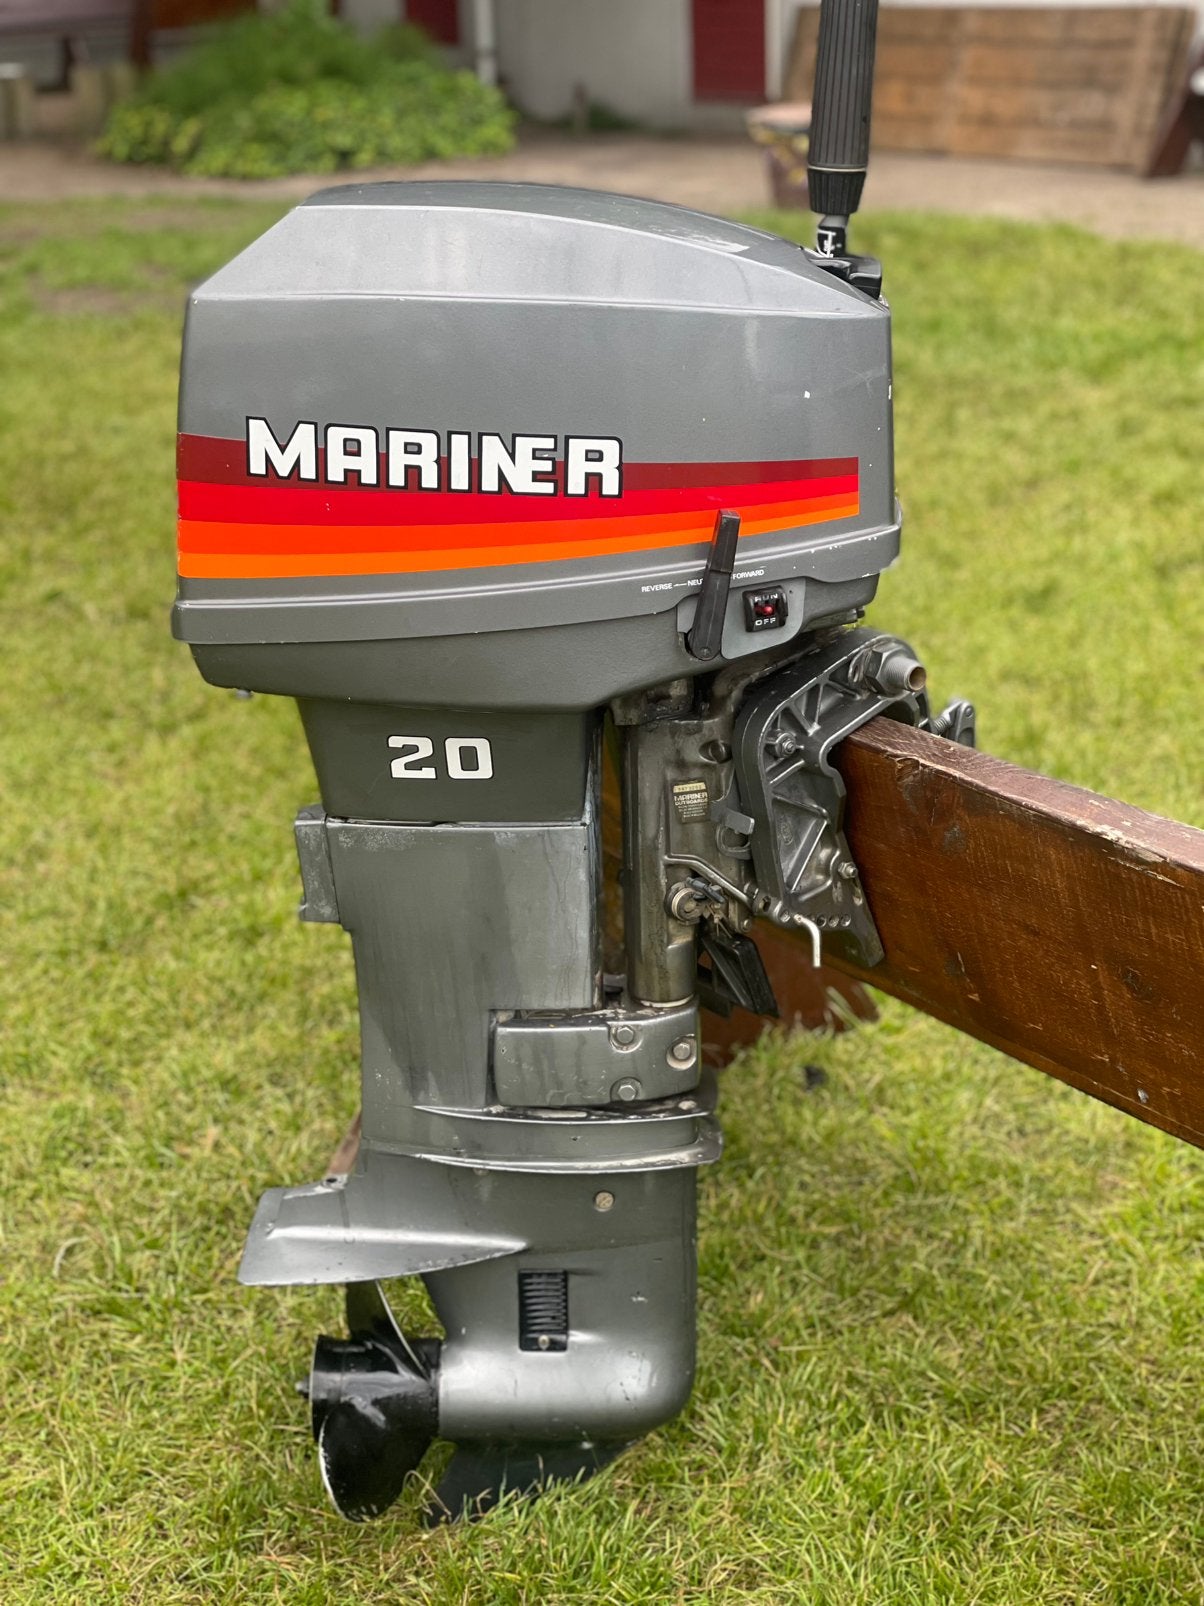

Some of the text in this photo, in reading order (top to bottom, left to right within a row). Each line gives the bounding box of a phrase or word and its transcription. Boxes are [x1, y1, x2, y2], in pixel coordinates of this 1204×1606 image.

[246, 416, 623, 499] MARINER
[641, 582, 673, 593] REVERSE
[732, 569, 765, 580] FORWARD
[754, 593, 778, 602] RUN
[755, 617, 776, 626] OFF
[387, 734, 494, 780] 20
